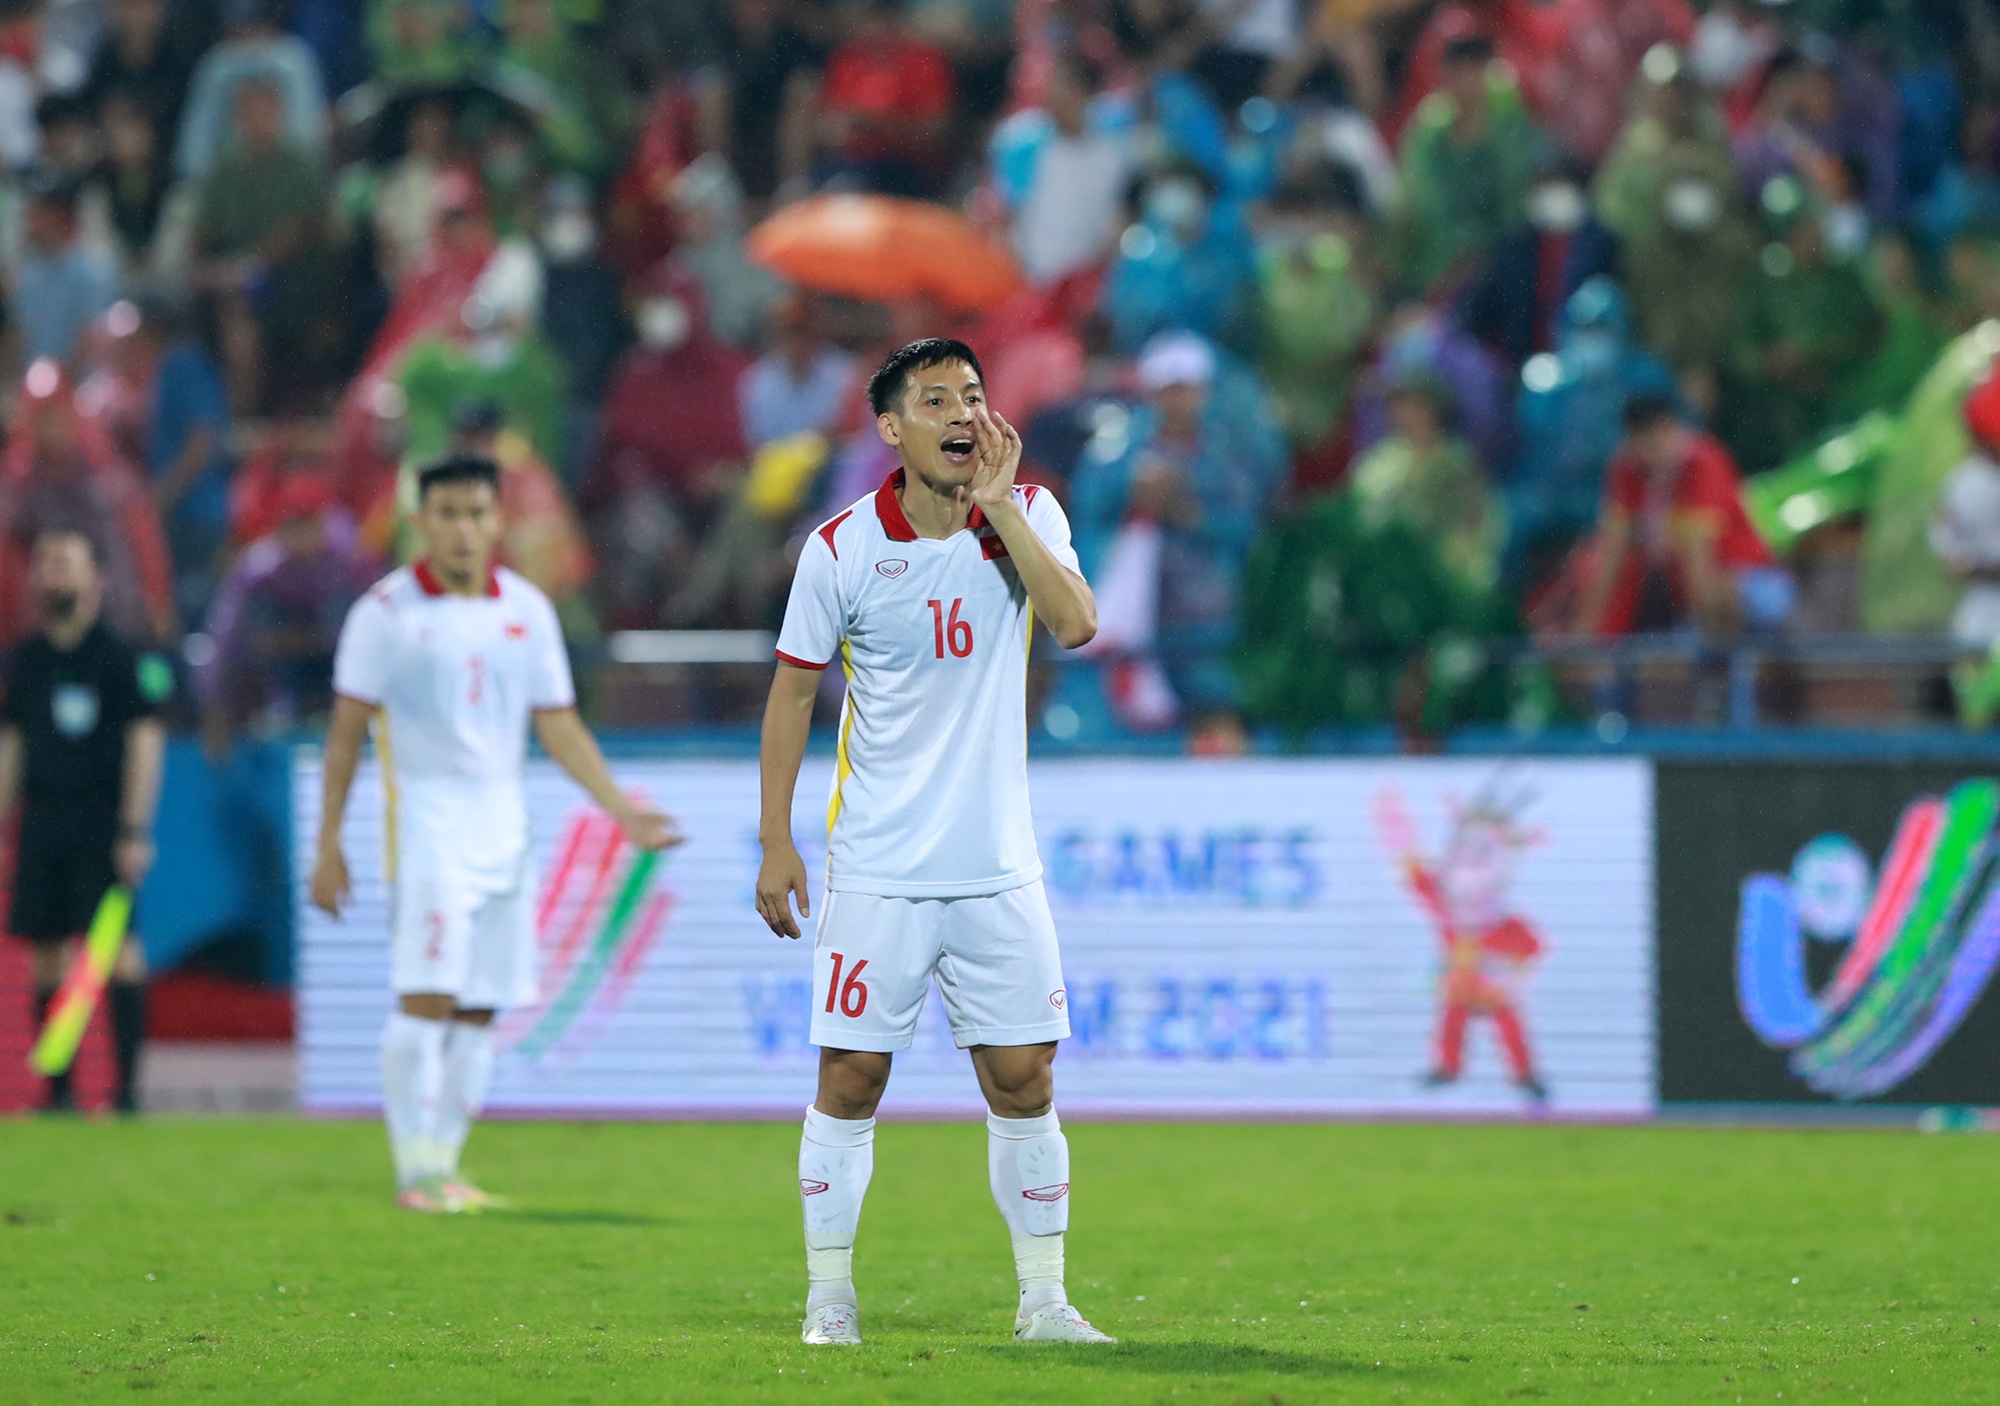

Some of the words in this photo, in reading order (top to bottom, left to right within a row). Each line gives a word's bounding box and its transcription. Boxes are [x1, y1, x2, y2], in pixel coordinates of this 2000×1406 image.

[927, 597, 974, 660] 16
[1052, 827, 1322, 907] GAMES
[421, 910, 446, 962] 2
[825, 951, 869, 1019] 16
[1147, 977, 1331, 1060] 2021
